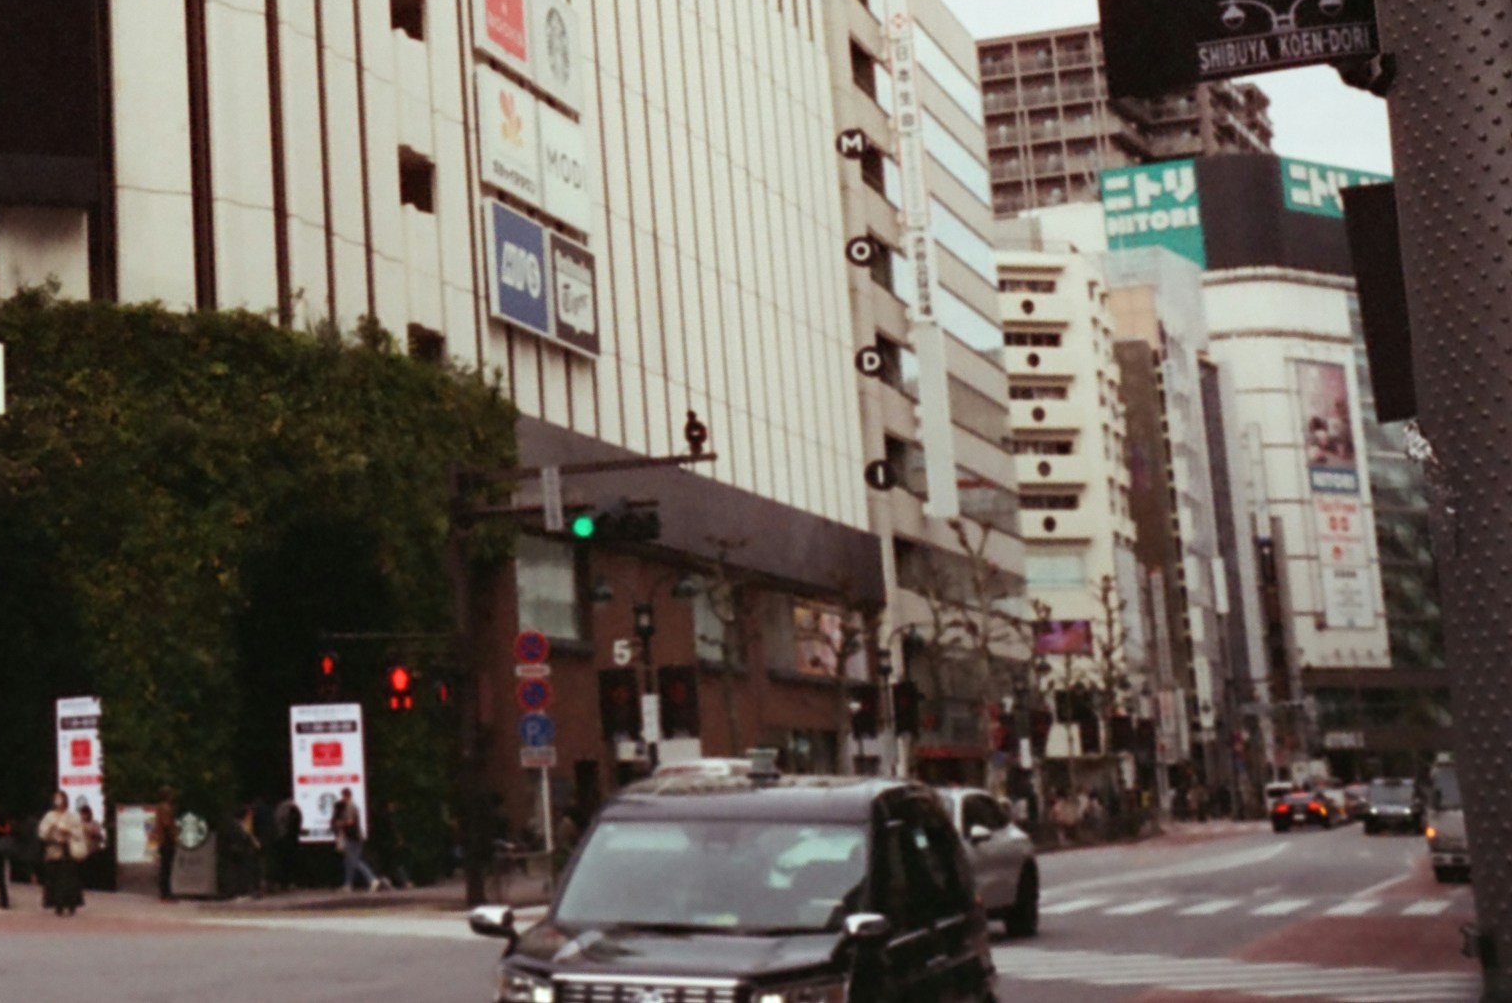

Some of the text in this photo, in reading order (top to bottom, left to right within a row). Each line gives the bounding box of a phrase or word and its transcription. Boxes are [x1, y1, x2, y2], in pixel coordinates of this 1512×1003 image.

[1198, 28, 1371, 72] SHIBUYA KOEN-DORI
[1103, 165, 1195, 211] ニトリ
[1106, 205, 1199, 236] NITORI
[613, 640, 632, 666] 5
